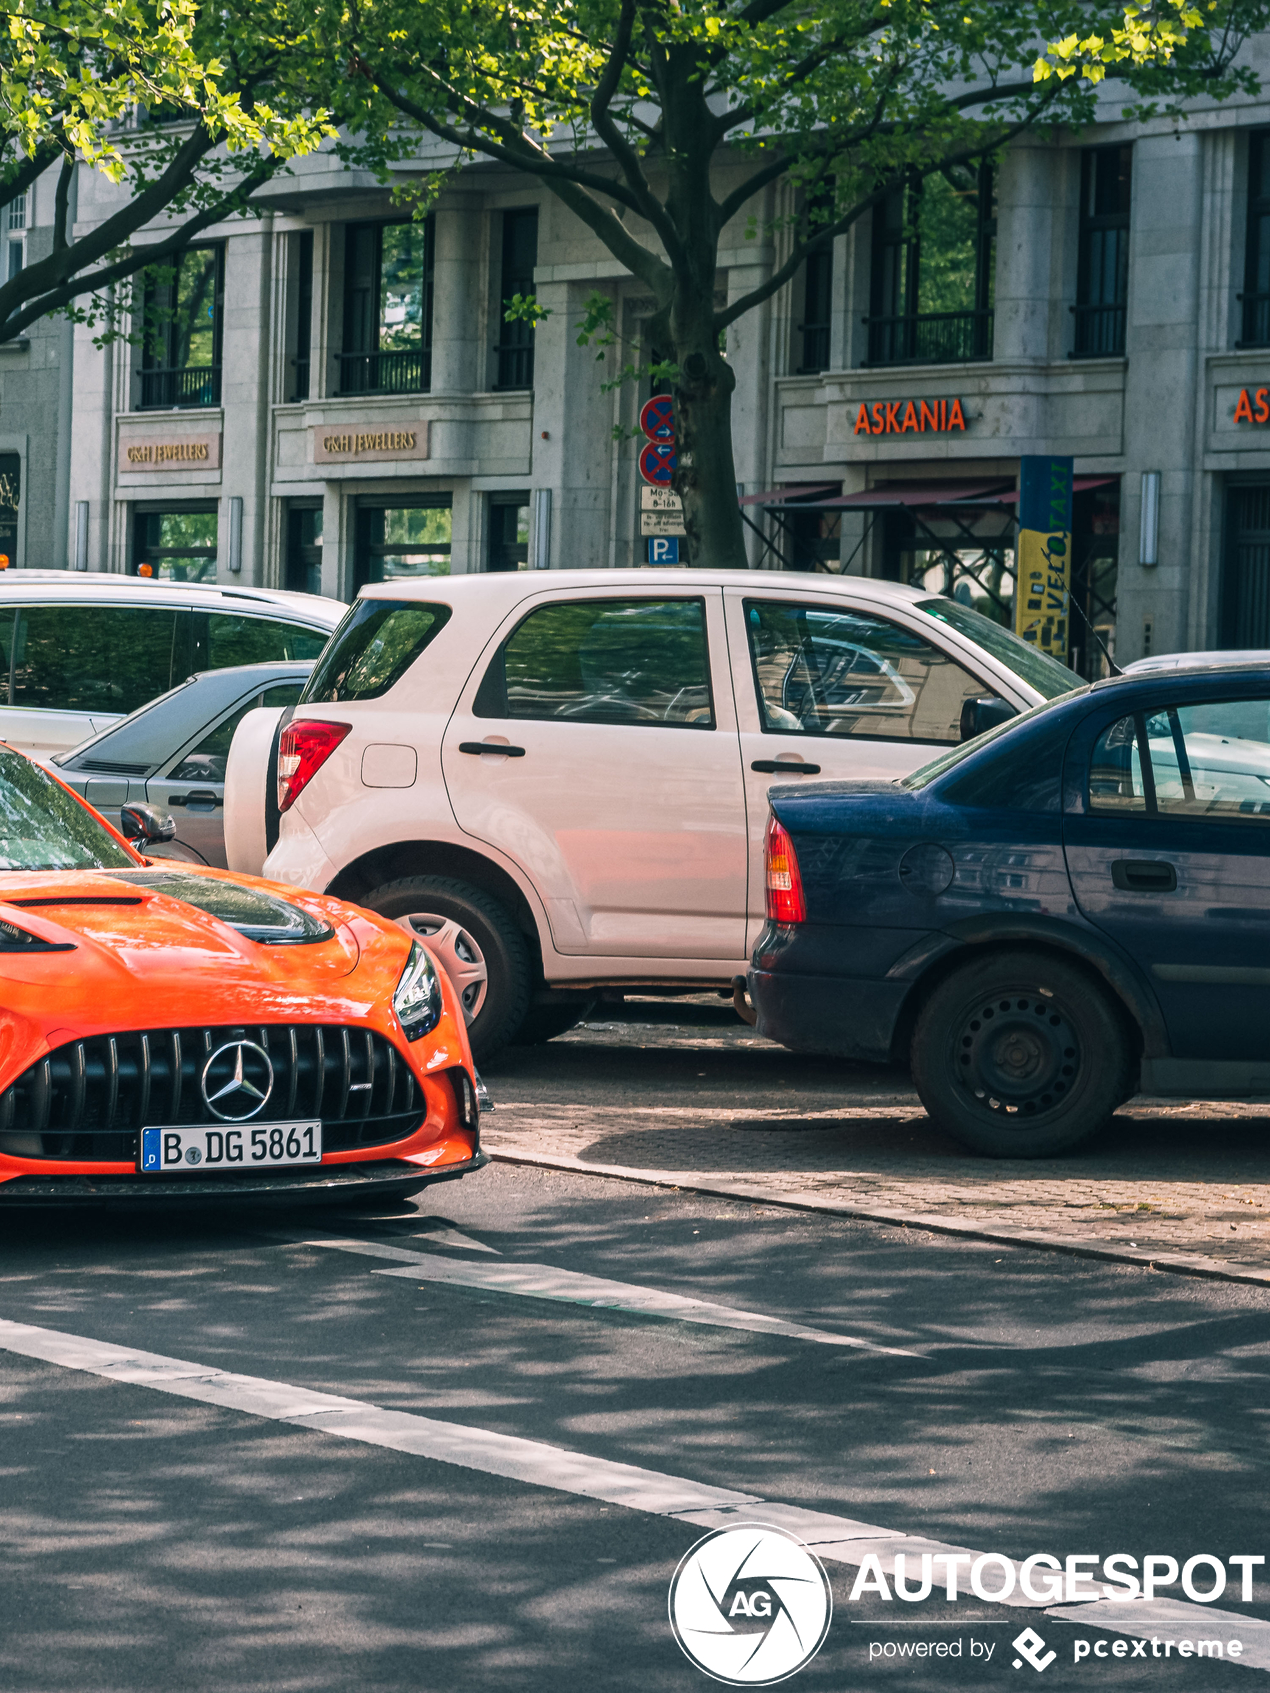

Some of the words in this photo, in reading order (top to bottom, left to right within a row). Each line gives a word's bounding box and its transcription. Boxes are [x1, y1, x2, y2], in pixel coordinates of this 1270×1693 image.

[854, 398, 965, 435] ASKANIA
[154, 443, 209, 464] JEWELLERS
[323, 434, 350, 453] G&H
[353, 432, 416, 455] JEWELLERS
[148, 1154, 156, 1164] D
[163, 1133, 182, 1164] B
[205, 1131, 243, 1163] DG
[251, 1126, 318, 1161] 5861
